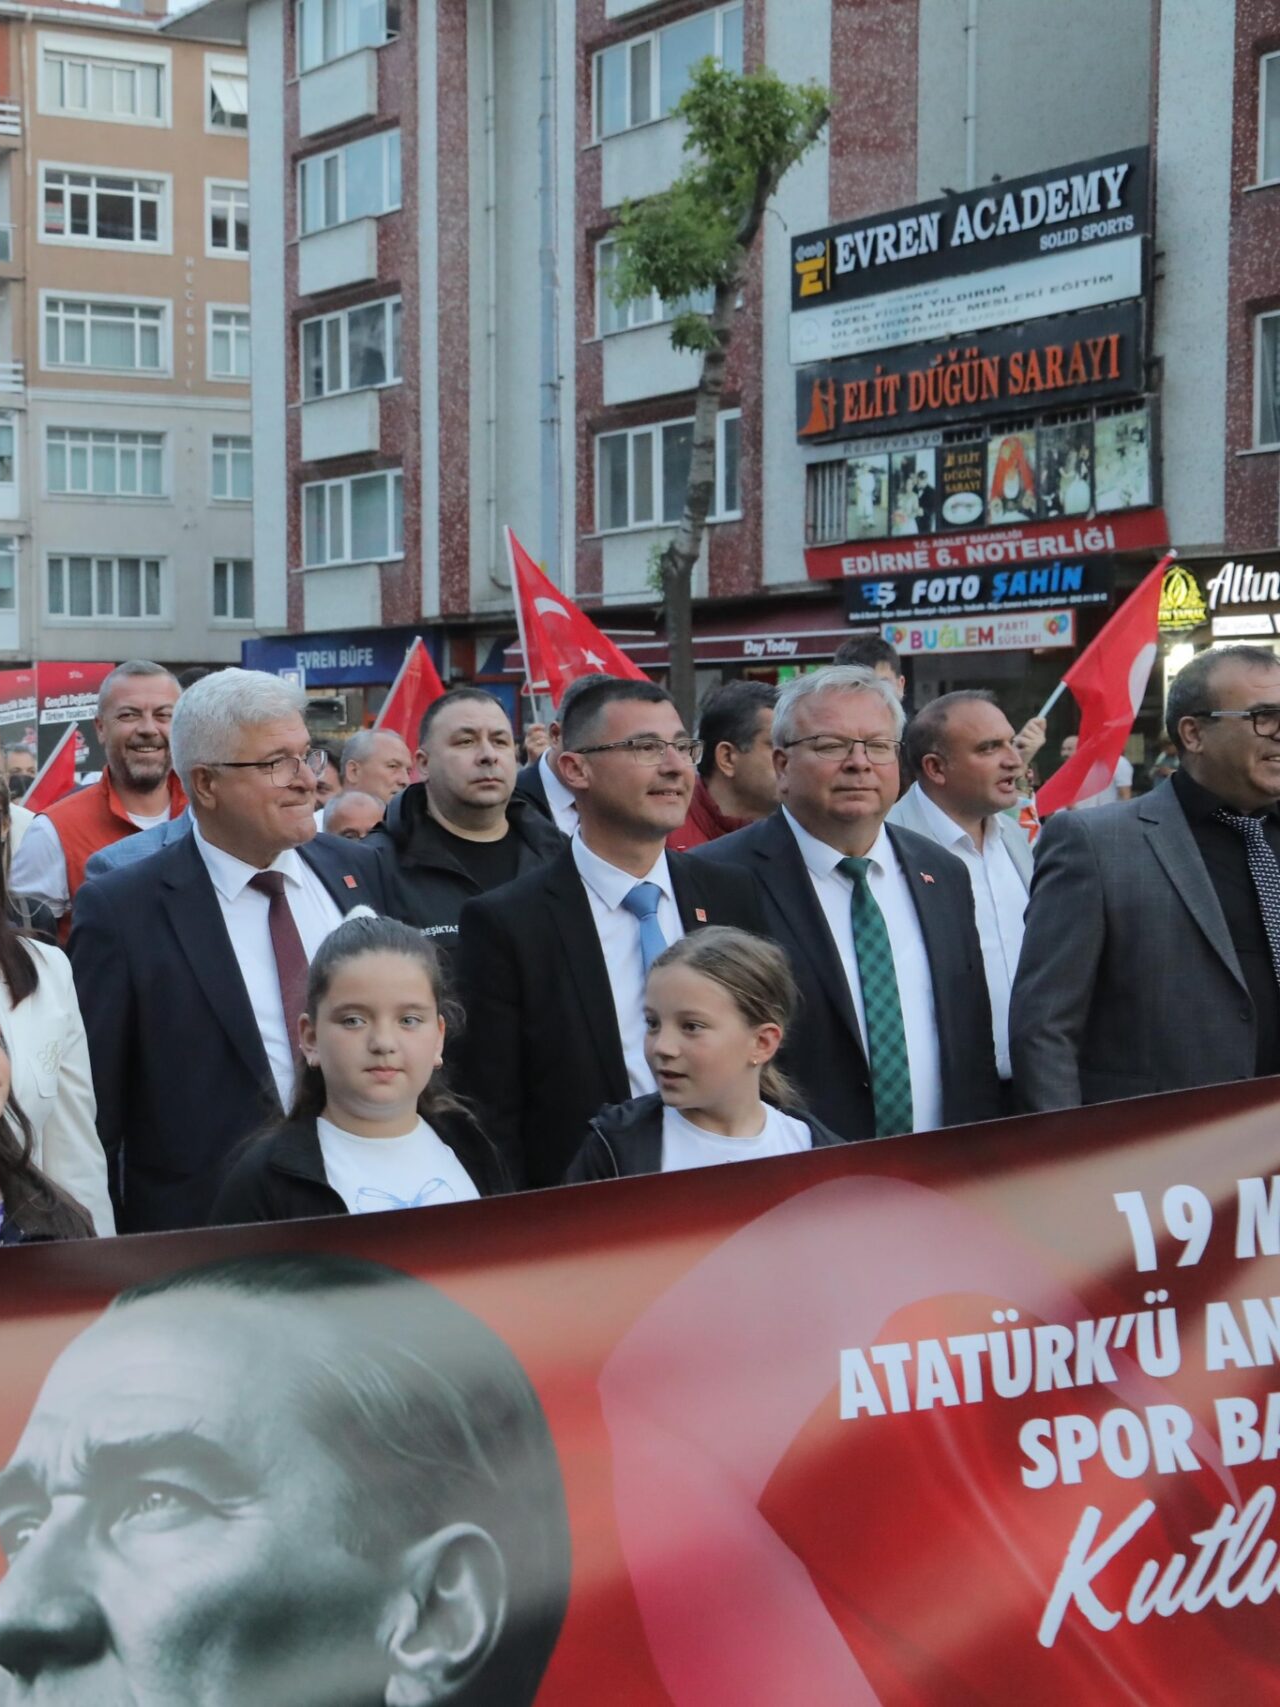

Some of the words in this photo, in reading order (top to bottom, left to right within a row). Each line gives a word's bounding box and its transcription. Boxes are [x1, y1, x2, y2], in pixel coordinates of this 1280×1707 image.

[834, 212, 941, 274] EVREN
[950, 163, 1129, 247] ACADEMY
[1039, 229, 1077, 251] SOLID
[1081, 215, 1134, 243] SPORTS
[928, 284, 1006, 309] YILDIRIM
[843, 364, 901, 424] ELİT
[908, 347, 1000, 411] DÜĞÜN
[1008, 334, 1120, 393] SARAYI
[841, 549, 930, 576] EDİRNE
[936, 549, 959, 568] 6.
[967, 525, 1116, 564] NOTERLİĞİ
[933, 536, 968, 549] ADALET
[970, 529, 1023, 545] BAKANLIĞI
[911, 575, 980, 605] FOTO
[992, 561, 1085, 603] ŞAHİN
[910, 623, 994, 649] BUĞLEM
[998, 620, 1029, 631] PARTİ
[998, 632, 1042, 645] SÜSLERİ
[296, 650, 337, 669] EVREN
[339, 645, 373, 667] BÜFE
[743, 639, 764, 656] Day
[766, 638, 798, 654] Today
[1113, 1184, 1214, 1273] 19
[839, 1288, 1182, 1420] ATATÜRK'Ü
[1019, 1404, 1202, 1490] SPOR
